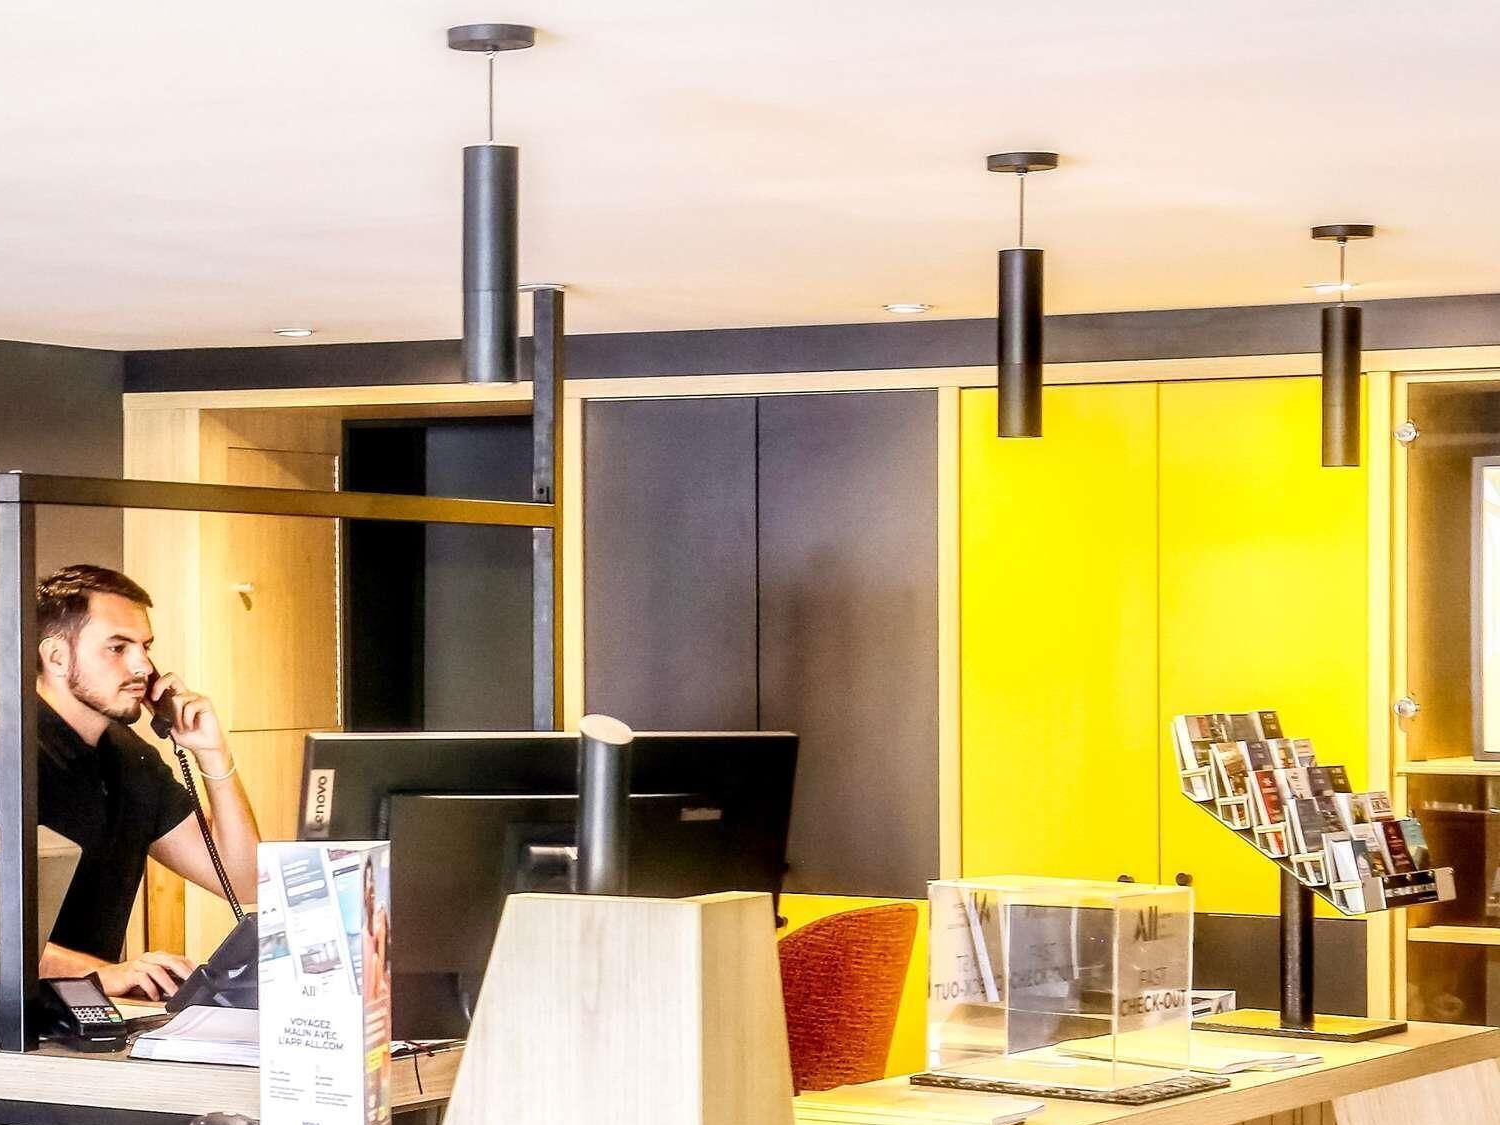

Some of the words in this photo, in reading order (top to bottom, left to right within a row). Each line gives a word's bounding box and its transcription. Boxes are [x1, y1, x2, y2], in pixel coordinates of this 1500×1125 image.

[309, 775, 328, 832] Lenovo
[1120, 989, 1187, 1017] CHECK-OUT
[290, 1017, 331, 1029] VOYAGEZ
[284, 1027, 311, 1037] MALIN
[314, 1030, 337, 1040] AVEC
[278, 1036, 302, 1046] L'APP
